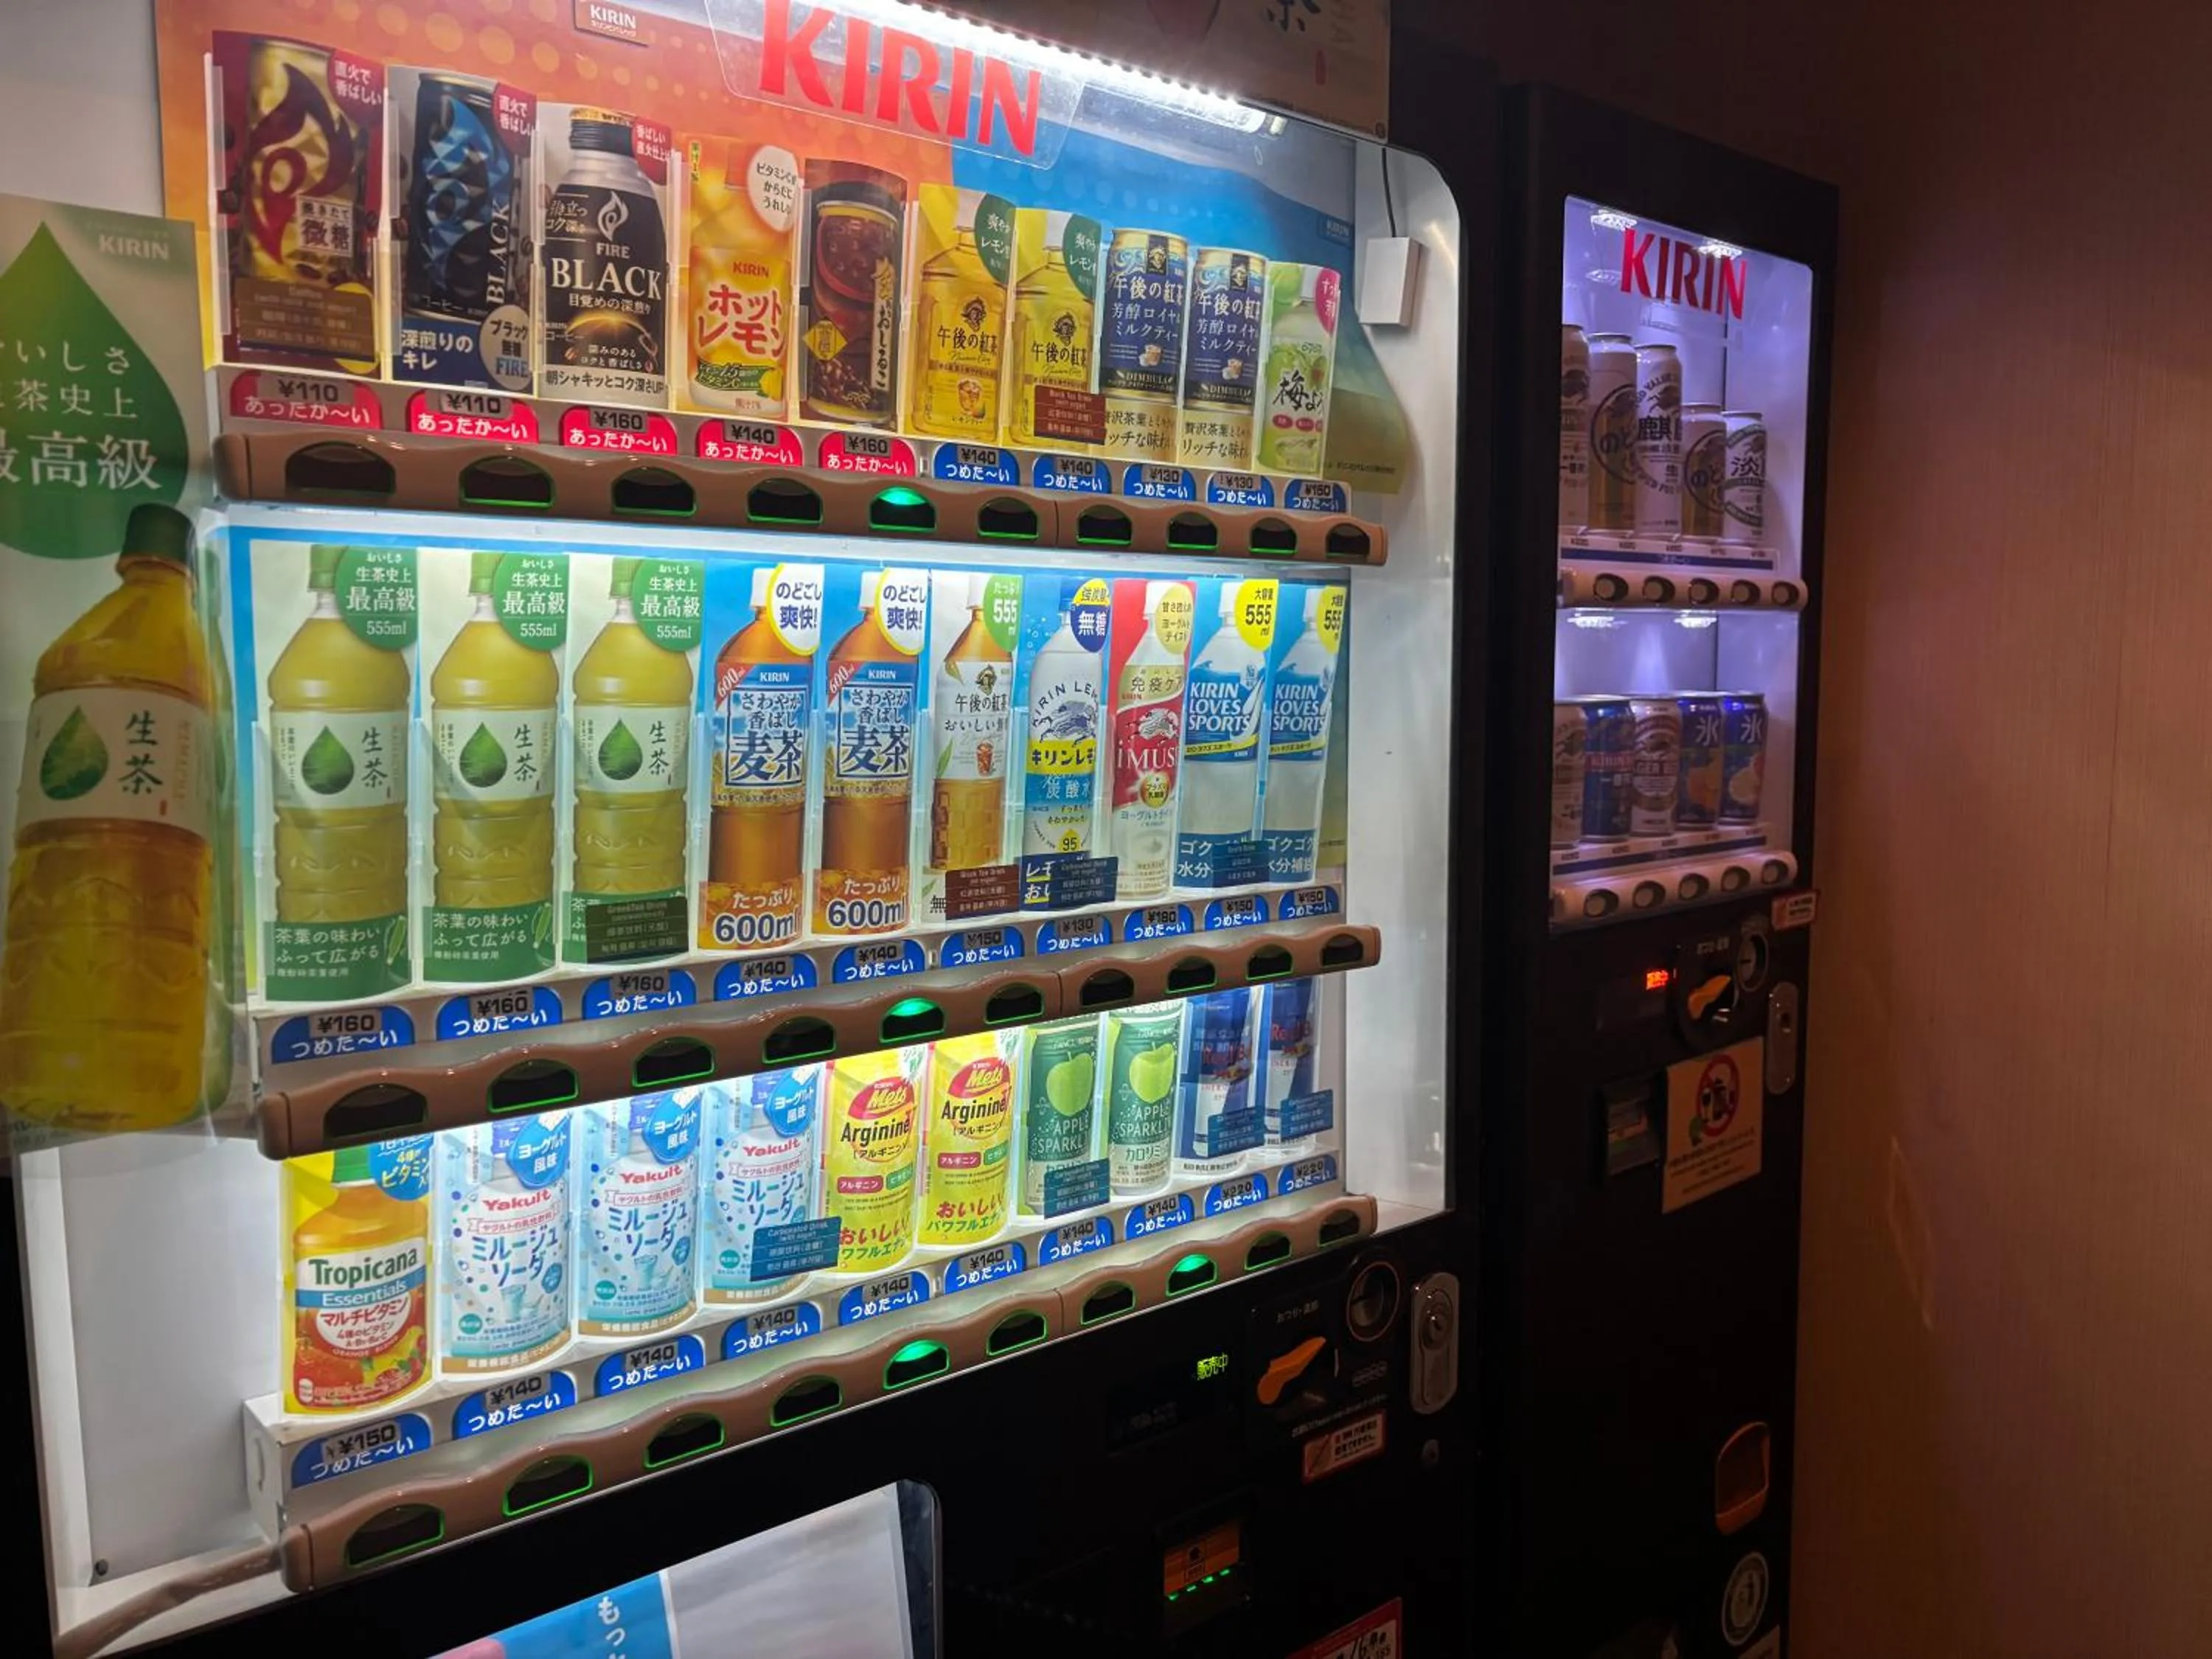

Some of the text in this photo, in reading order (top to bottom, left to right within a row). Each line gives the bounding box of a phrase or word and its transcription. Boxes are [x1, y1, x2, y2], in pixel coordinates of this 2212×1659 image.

[589, 5, 637, 29] KIRIN
[334, 60, 372, 86] 直火で
[759, 0, 1042, 157] KIRIN
[335, 78, 383, 106] 香ばしい
[498, 94, 528, 117] 直火で
[302, 219, 350, 251] 微糖
[99, 234, 170, 261] KIRIN
[487, 200, 510, 305] BLACK
[596, 242, 630, 259] FIRE
[551, 257, 663, 300] BLACK
[733, 261, 770, 278] KIRIN
[1618, 227, 1747, 320] KIRIN
[568, 293, 652, 315] 目覚めの深煎り
[708, 283, 783, 327] ホット
[401, 329, 473, 353] 深煎りの
[490, 319, 529, 341] ブラック
[698, 315, 787, 358] レモン
[0, 340, 131, 375] いしさ
[403, 350, 437, 370] キレ
[0, 379, 139, 419] 茶史上
[278, 379, 339, 403] ¥110
[445, 392, 501, 414] ¥110
[593, 410, 644, 431] ¥160
[731, 424, 776, 443] ¥140
[848, 435, 888, 453] ¥160
[961, 447, 996, 465] ¥140
[1060, 458, 1093, 476] ¥140
[1150, 466, 1180, 483] ¥130
[355, 566, 412, 583] 生茶史上
[512, 571, 563, 588] 生茶史上
[648, 577, 698, 593] 生茶史上
[345, 585, 417, 611] 最高級
[775, 581, 822, 601] のどごし
[883, 585, 927, 603] のどごし
[501, 591, 566, 616] 最高級
[639, 594, 700, 618] 最高級
[992, 598, 1018, 624] 555
[779, 604, 818, 630] 爽快!
[887, 606, 923, 630] 爽快!
[1077, 611, 1107, 636] 無糖
[1245, 604, 1272, 626] 555
[366, 620, 406, 636] 555ml
[519, 622, 557, 637] 555ml
[656, 625, 692, 639] 555ml
[759, 671, 790, 683] KIRIN
[868, 668, 897, 680] KIRIN
[741, 692, 801, 711] さわやか
[851, 689, 909, 708] さわやか
[1190, 682, 1239, 699] KIRIN
[1275, 684, 1318, 700] KIRIN
[858, 706, 905, 724] 香ばし
[1189, 698, 1242, 716] LOVES
[1273, 699, 1320, 716] LOVES
[749, 712, 797, 730] 香ばし
[1187, 714, 1251, 733] SPORTS
[1272, 714, 1326, 732] SPORTS
[1696, 715, 1718, 746] 氷
[1740, 714, 1761, 744] 氷
[117, 709, 164, 796] 生茶
[361, 726, 389, 789] 生茶
[513, 723, 537, 782] 生茶
[648, 720, 669, 776] 生茶
[730, 730, 804, 782] 麦茶
[841, 724, 909, 774] 麦茶
[844, 874, 902, 896] たっぷり
[732, 887, 794, 911] たっぷり
[433, 913, 529, 929] 茶葉の味わい
[1061, 917, 1094, 933] ¥130
[274, 928, 380, 945] 茶葉の味わい
[434, 929, 528, 947] ふって広がる
[276, 945, 380, 964] ふって広がる
[858, 945, 898, 962] ¥140
[744, 961, 786, 978] ¥140
[618, 975, 665, 992] ¥160
[476, 995, 528, 1017] ¥160
[317, 1013, 376, 1034] ¥160
[774, 1088, 814, 1110] ヨーグルト
[941, 1093, 1008, 1125] Arginine
[653, 1110, 698, 1134] ヨーグルト
[840, 1115, 911, 1148] Arginine
[518, 1133, 567, 1160] ヨーグルト
[742, 1138, 801, 1158] Yakult
[939, 1155, 978, 1166] アルギニン
[619, 1164, 684, 1185] Yakult
[840, 1180, 879, 1189] アルギニン
[731, 1169, 805, 1203] ミルージュ
[1222, 1181, 1253, 1200] ¥220
[482, 1188, 552, 1212] Yakult
[748, 1194, 794, 1226] ソーダ
[936, 1192, 1004, 1220] おいしい
[1147, 1198, 1177, 1218] ¥140
[608, 1198, 688, 1232] ミルージュ
[626, 1223, 676, 1257] ソーダ
[840, 1216, 910, 1245] おいしい
[1062, 1222, 1095, 1240] ¥140
[471, 1225, 559, 1262] ミルージュ
[308, 1248, 419, 1289] Tropicana
[968, 1248, 1004, 1270] ¥140
[491, 1253, 546, 1288] ソーダ
[321, 1280, 407, 1307] Essentials
[871, 1276, 911, 1298] ¥140
[320, 1298, 408, 1326] マルチビタミン
[752, 1308, 796, 1330] ¥140
[629, 1345, 675, 1368] ¥140
[1197, 1352, 1229, 1381] 販売中
[490, 1376, 543, 1403] ¥140
[597, 1596, 627, 1659] もっ
